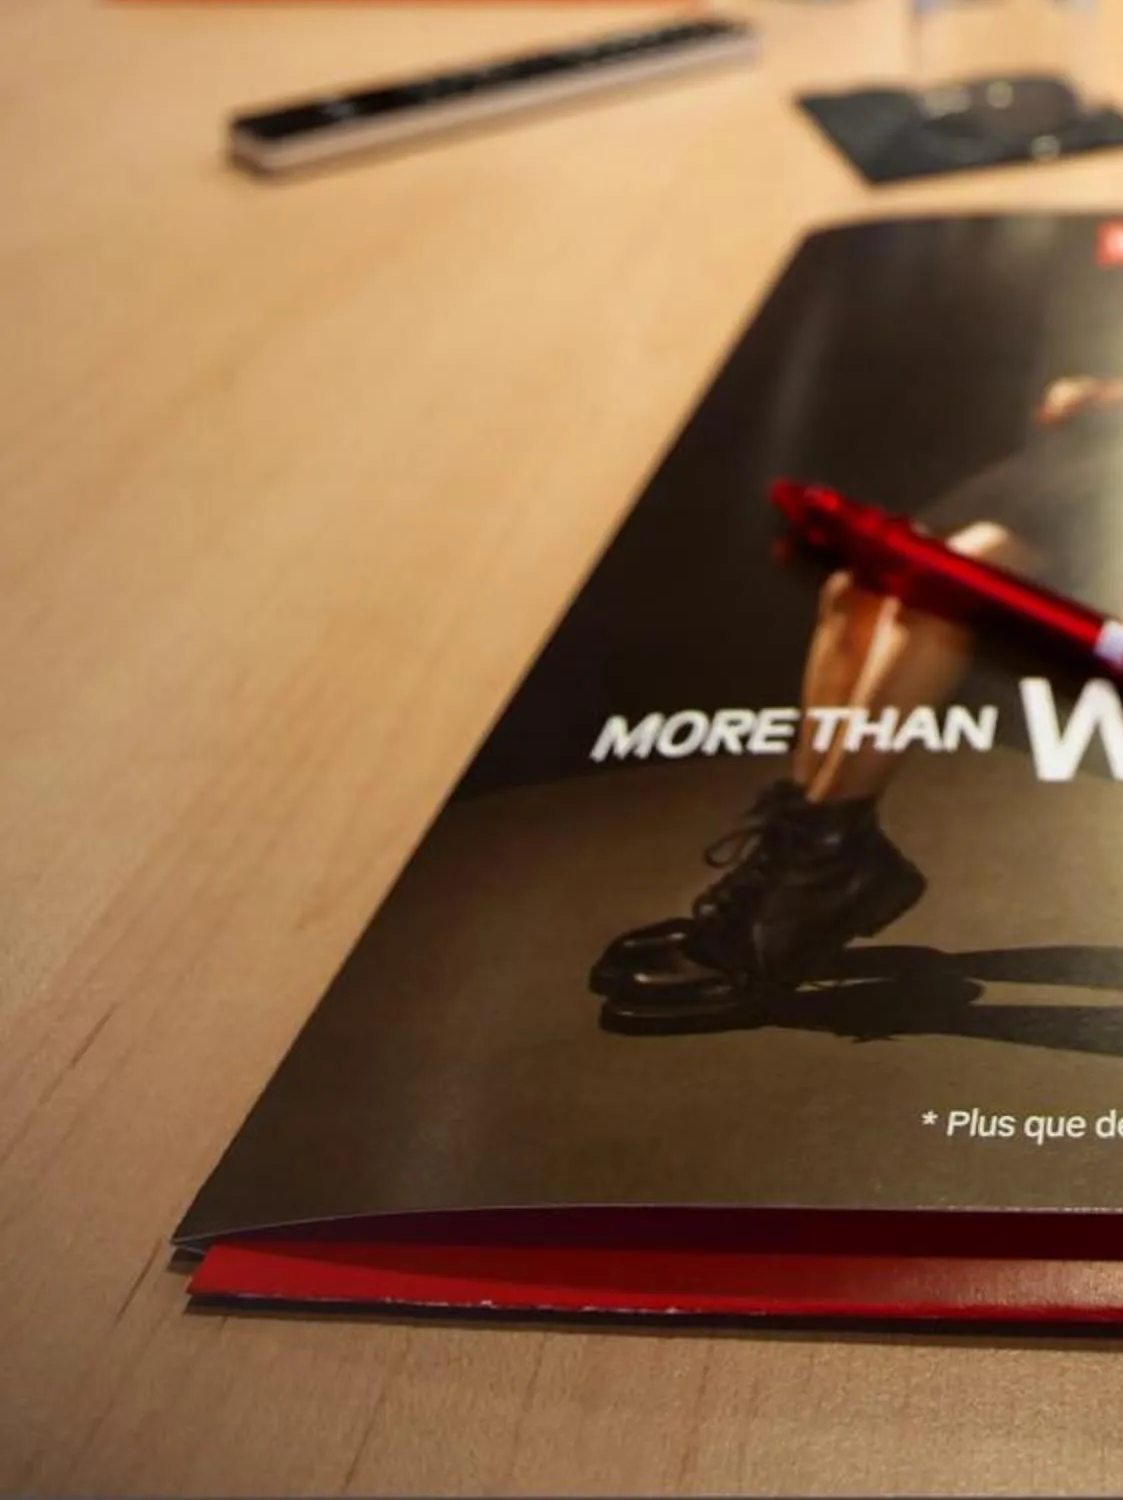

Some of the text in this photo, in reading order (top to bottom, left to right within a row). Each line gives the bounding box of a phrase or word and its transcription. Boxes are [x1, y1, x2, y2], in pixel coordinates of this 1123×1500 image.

[590, 707, 800, 762] MORE
[805, 704, 999, 754] THAN
[945, 1106, 1017, 1138] Plus
[1022, 1114, 1089, 1147] que
